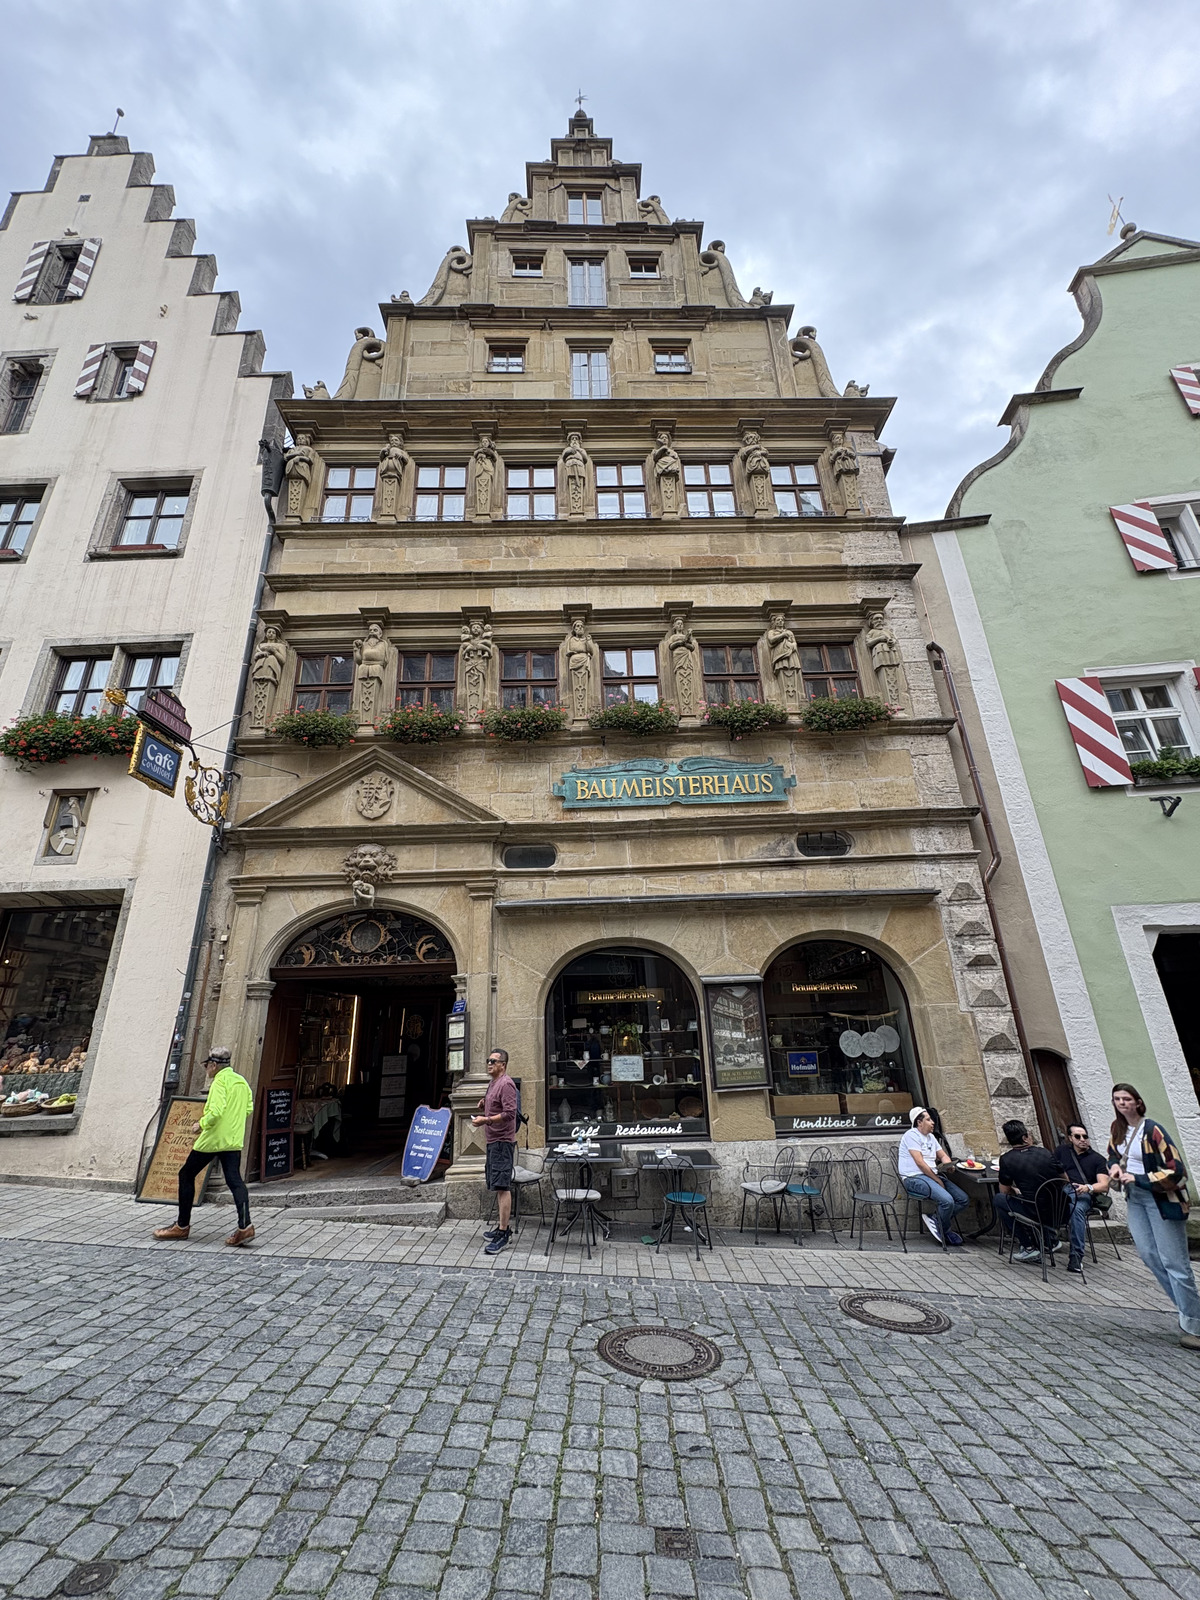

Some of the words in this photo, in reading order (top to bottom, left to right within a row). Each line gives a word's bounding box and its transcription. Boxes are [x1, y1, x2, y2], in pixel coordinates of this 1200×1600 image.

[146, 743, 175, 771] Cafe
[575, 773, 774, 800] BAUMEISTERHAUS
[791, 1063, 817, 1071] Hofmühl
[792, 1116, 857, 1129] Konditorei
[874, 1115, 902, 1126] Café
[413, 1125, 443, 1137] Restaurant
[571, 1125, 600, 1138] Café
[615, 1123, 683, 1136] Restaurant
